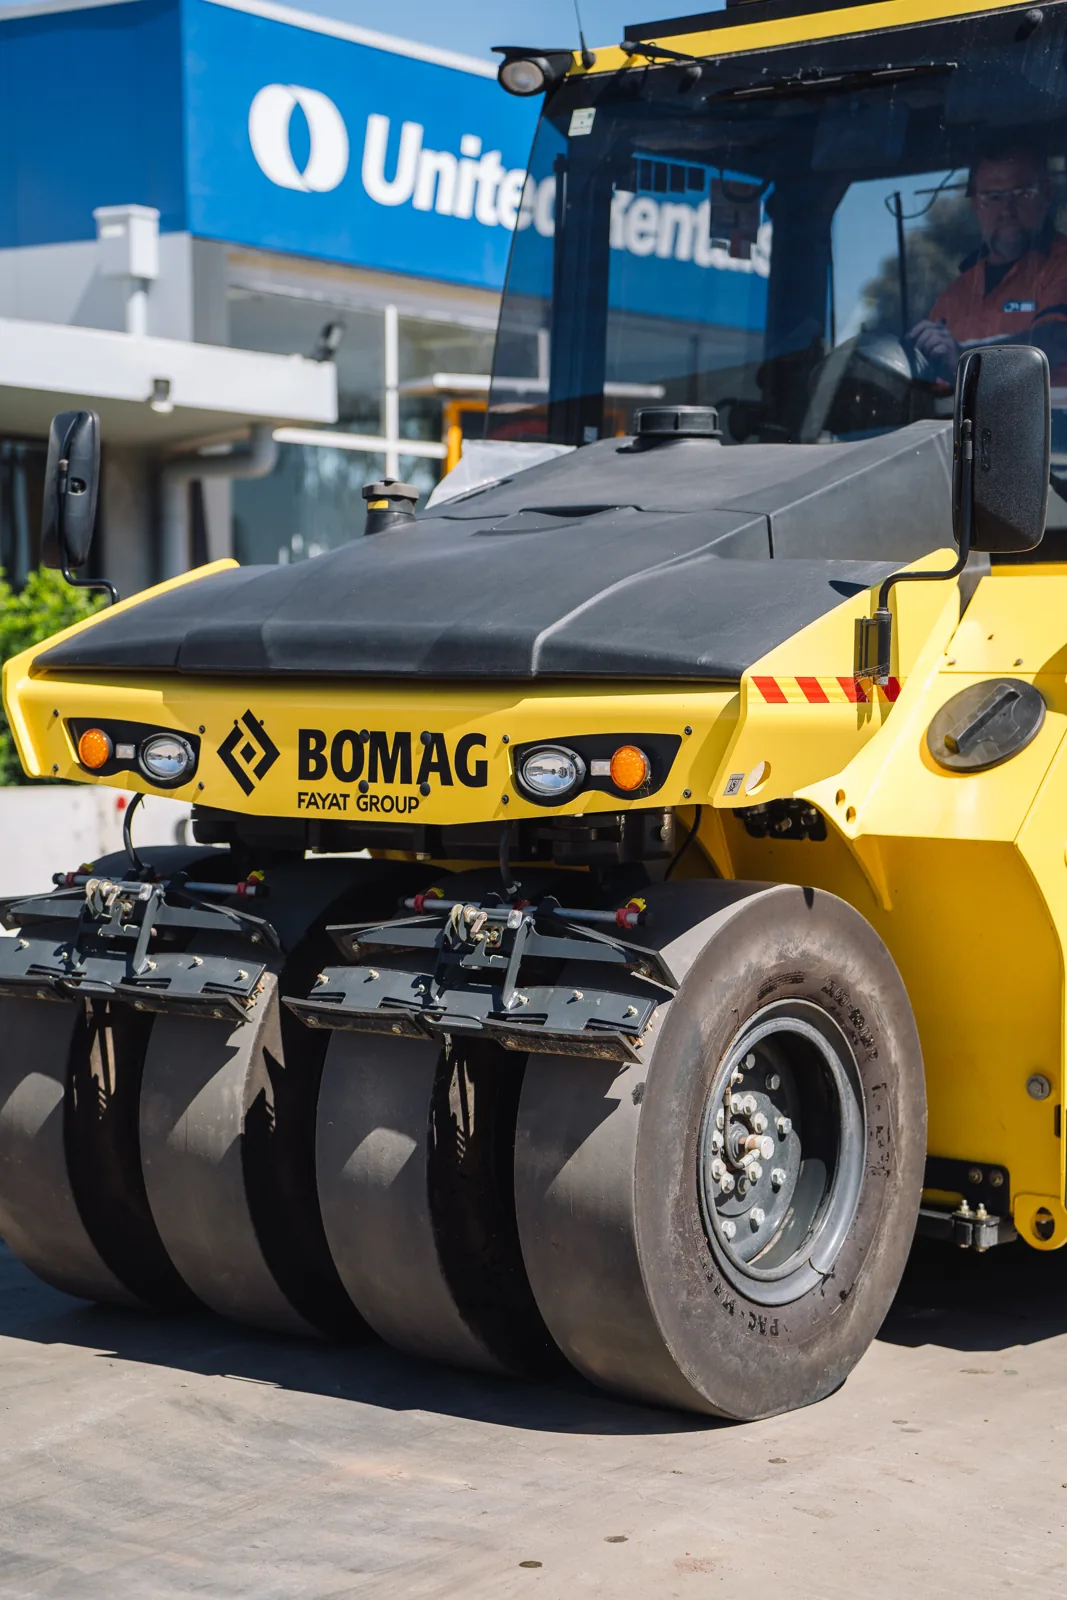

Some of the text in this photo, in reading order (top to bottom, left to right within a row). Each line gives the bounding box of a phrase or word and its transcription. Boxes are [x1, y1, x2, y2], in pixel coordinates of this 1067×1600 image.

[297, 729, 489, 788] BOMAG
[297, 792, 420, 814] FAYAT GROUP
